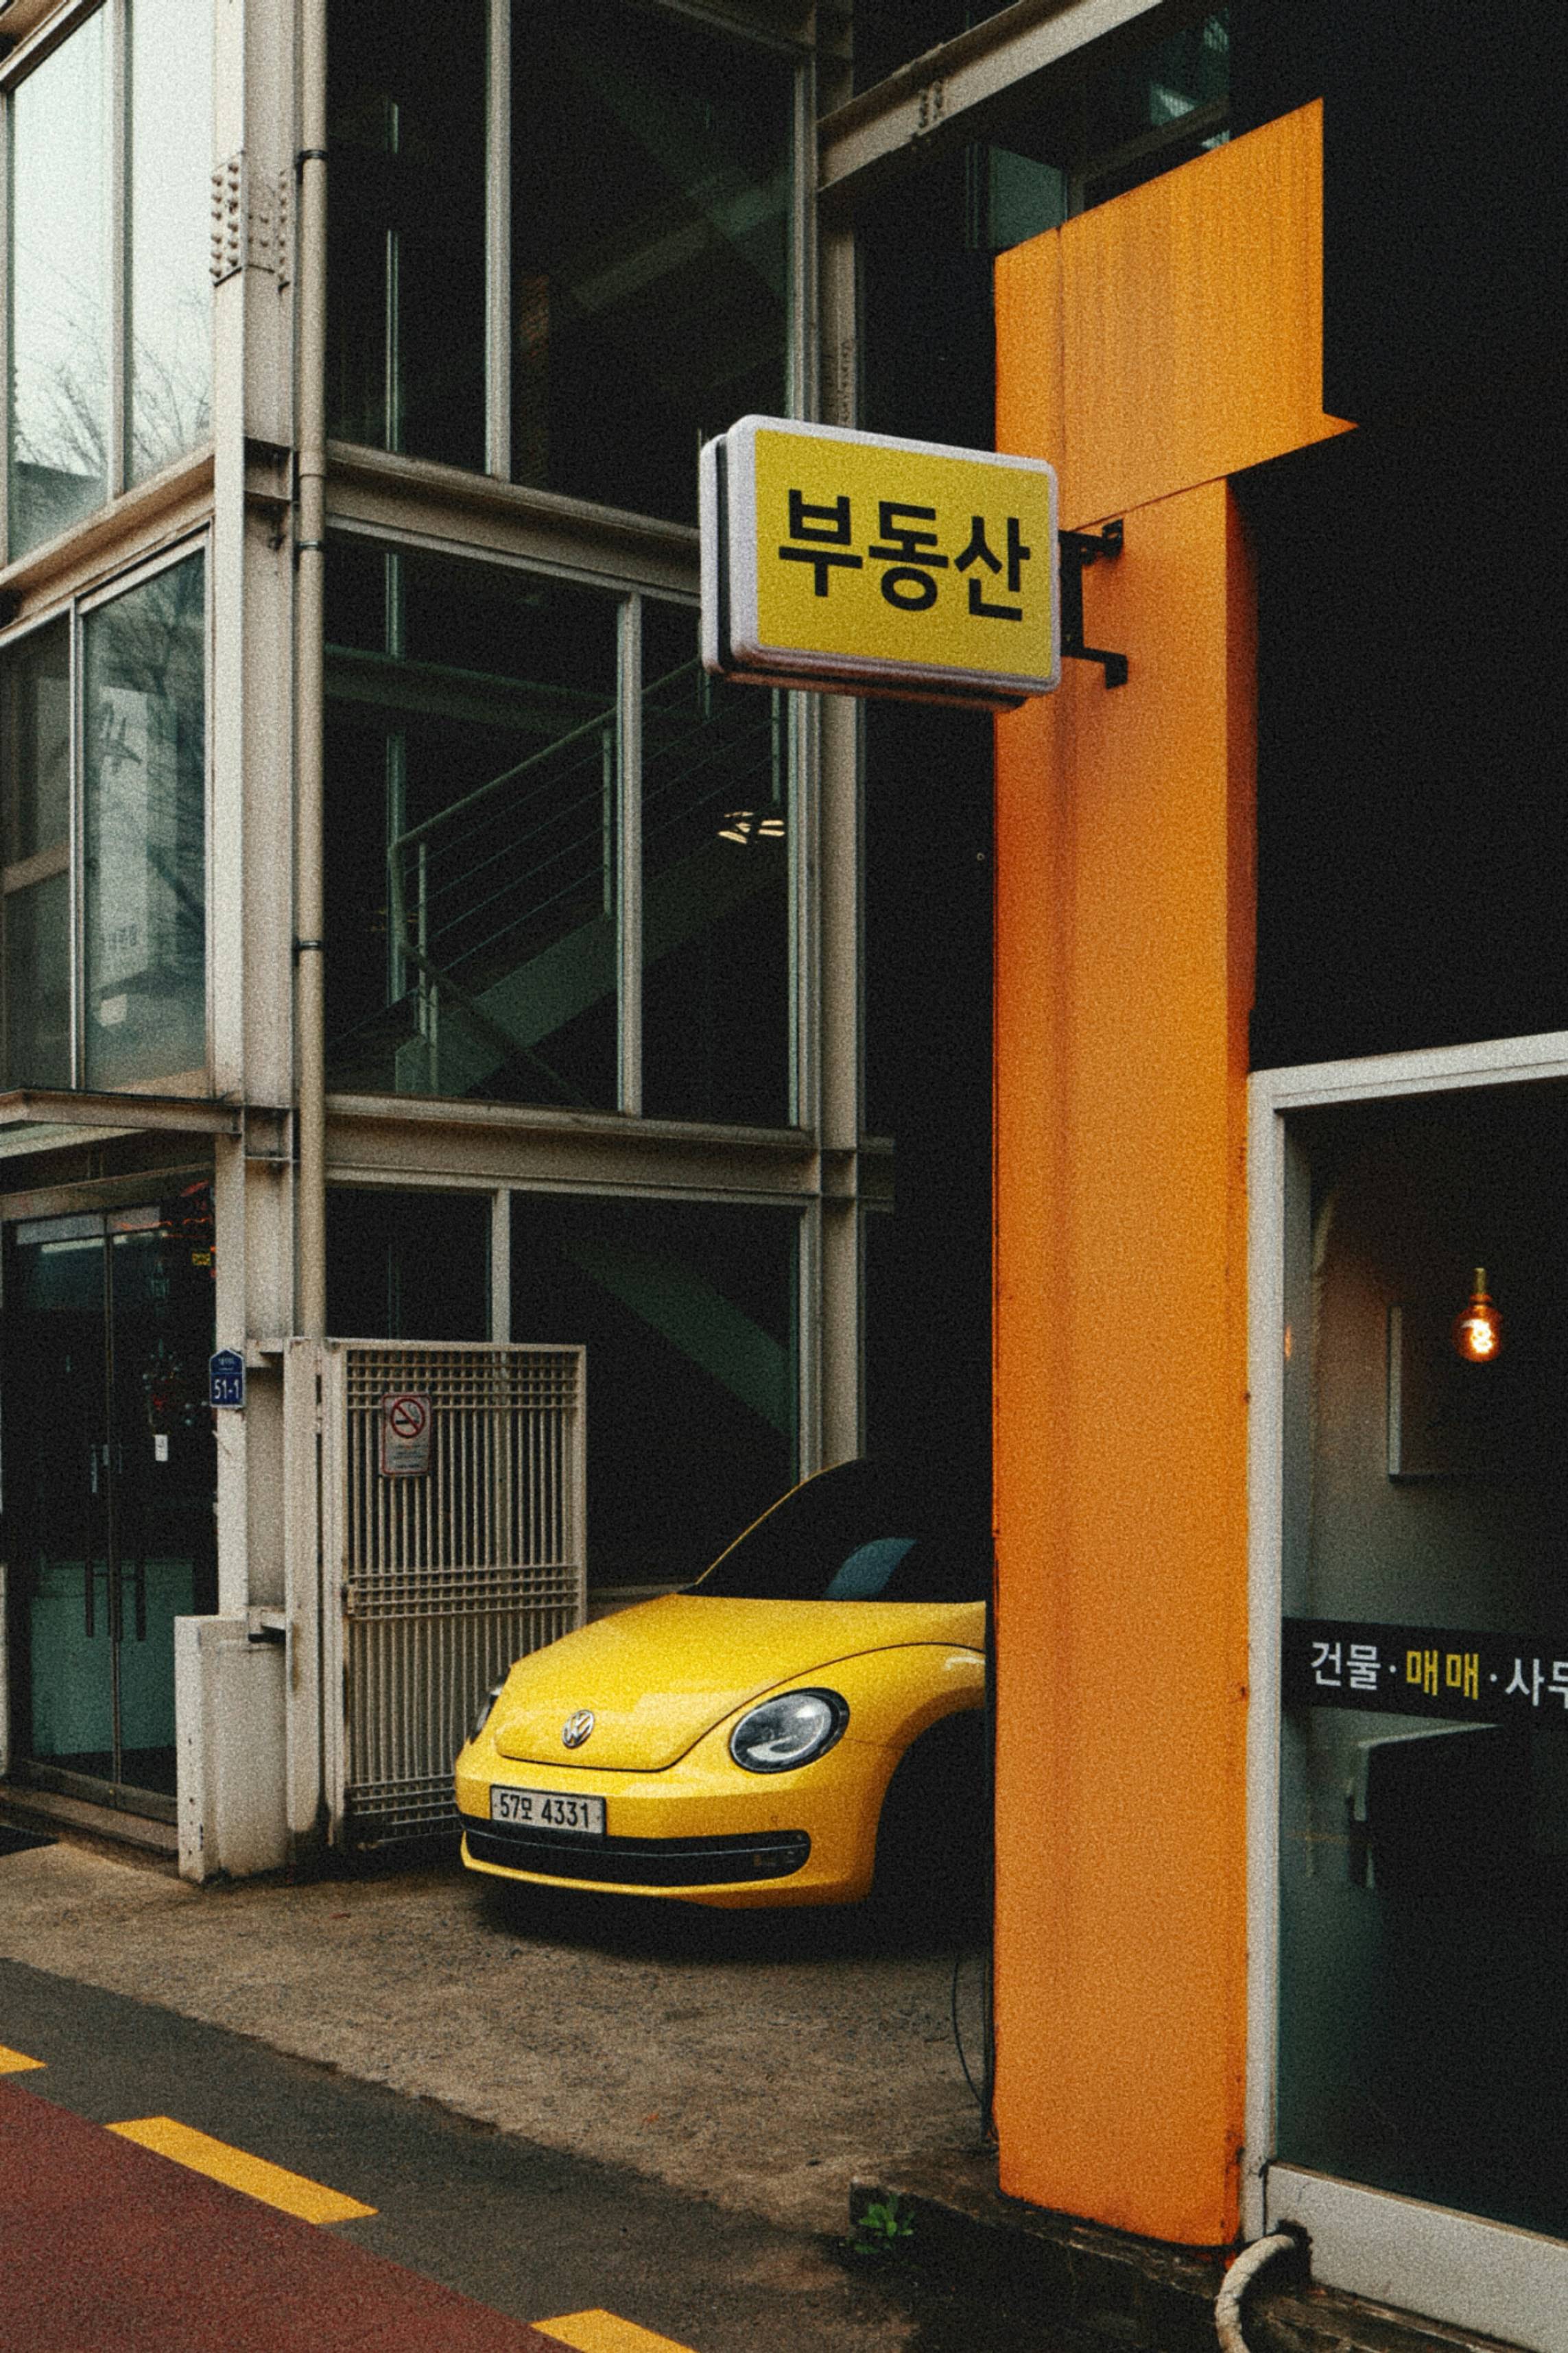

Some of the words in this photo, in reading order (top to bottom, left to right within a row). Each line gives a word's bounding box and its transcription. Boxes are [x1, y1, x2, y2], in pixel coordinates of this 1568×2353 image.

[779, 489, 1030, 621] 부동산
[215, 1379, 239, 1399] 51-1
[541, 1799, 589, 1828] 4331
